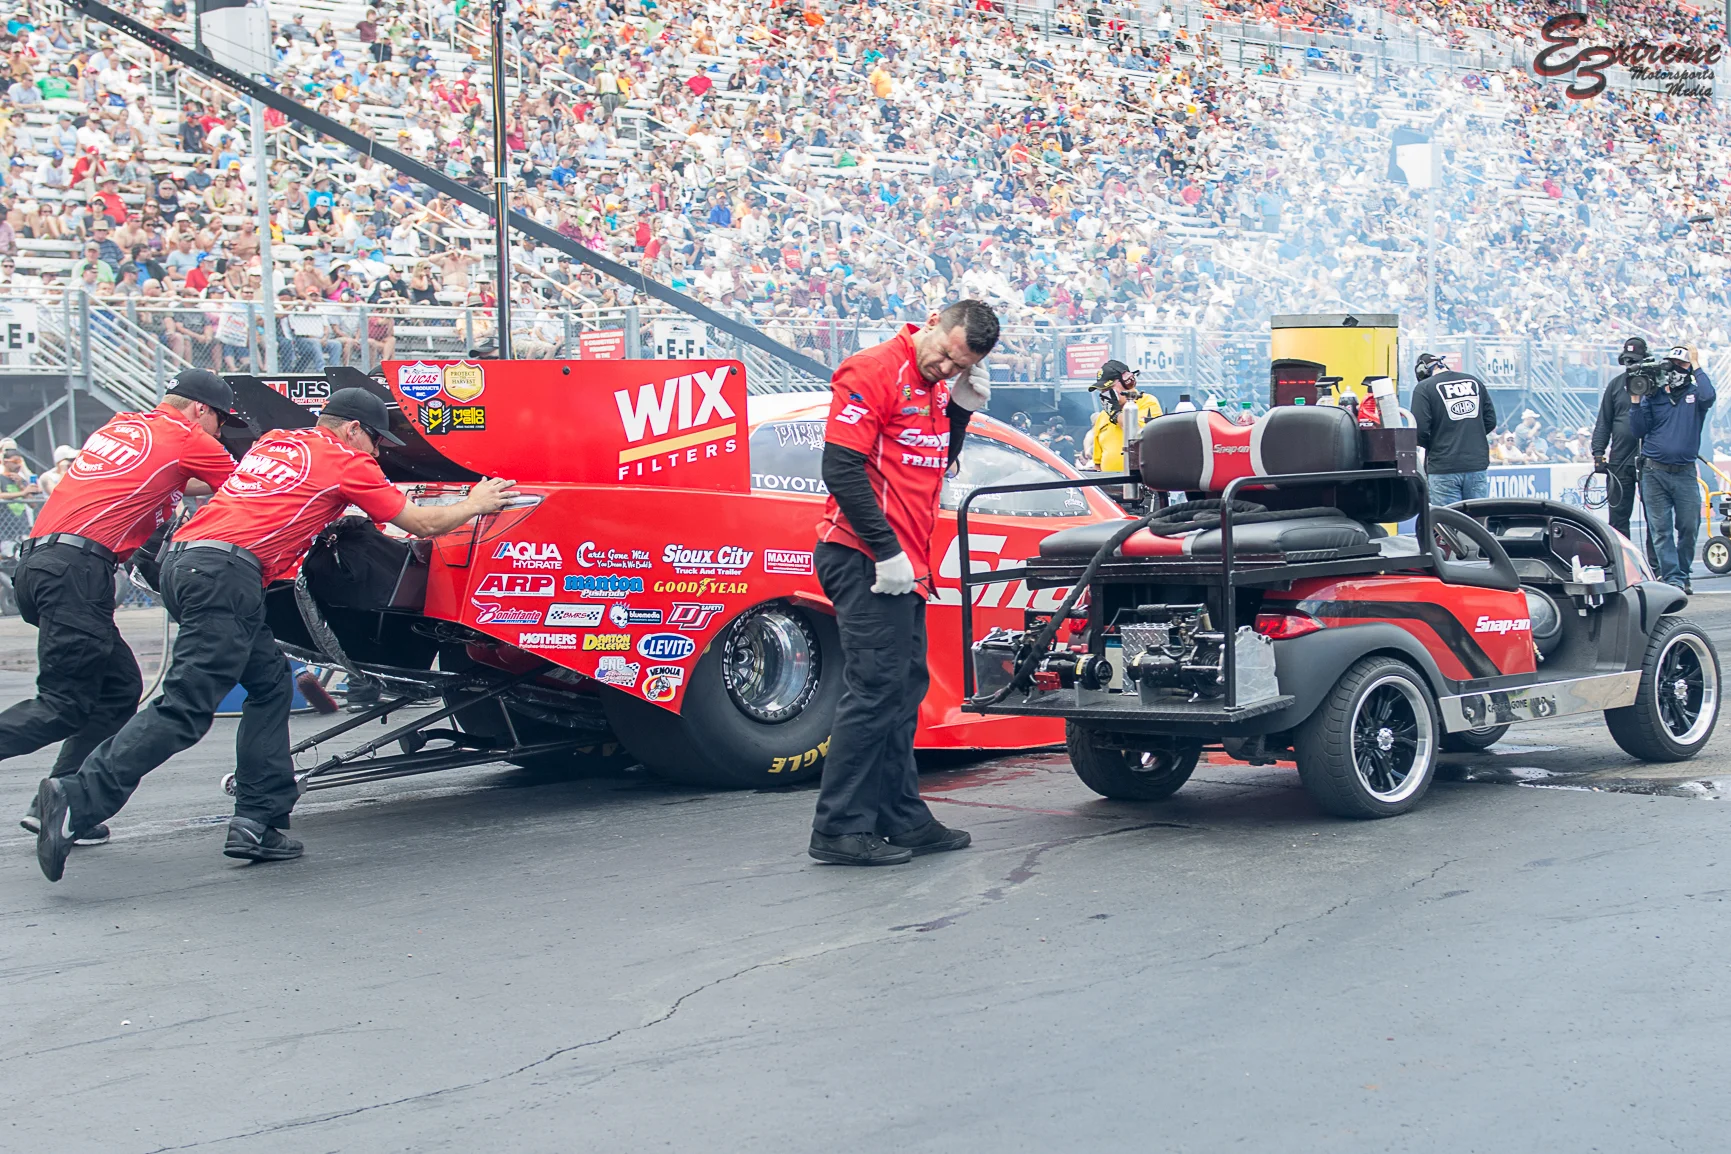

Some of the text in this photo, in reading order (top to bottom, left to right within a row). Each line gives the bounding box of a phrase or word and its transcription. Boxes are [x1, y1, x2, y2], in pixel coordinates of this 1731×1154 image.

[405, 374, 438, 384] LUCAS
[292, 382, 330, 398] JES
[1444, 381, 1476, 398] FOX
[614, 365, 736, 443] WIX
[895, 428, 950, 452] Snap
[1213, 443, 1251, 455] Snap-on
[618, 439, 737, 481] FILTERS
[902, 453, 949, 468] FRANC
[266, 464, 299, 484] IT
[752, 473, 830, 494] TOYOTA
[1487, 475, 1549, 499] ATIONS...
[501, 541, 562, 561] AQUA
[576, 541, 650, 568] Carts Gone Wild
[661, 544, 754, 568] Sioux City
[767, 552, 811, 565] MAXANT
[513, 560, 562, 570] HYDRATE
[675, 567, 698, 575] Truck
[717, 568, 743, 576] Trailer
[478, 575, 554, 593] ARP
[565, 574, 644, 592] manton
[582, 589, 626, 598] Pushrods
[563, 611, 588, 619] BMRS
[629, 611, 661, 619] bluemedia
[1474, 616, 1531, 635] Snap-on
[519, 633, 577, 644] MOTHERS
[582, 633, 631, 651] DARTON
[596, 642, 631, 651] SLEEVES
[640, 635, 694, 656] CLEVITE
[600, 657, 624, 671] CNC
[722, 640, 733, 690] WELD
[1511, 699, 1528, 709] GONE
[767, 734, 832, 773] AGLE
